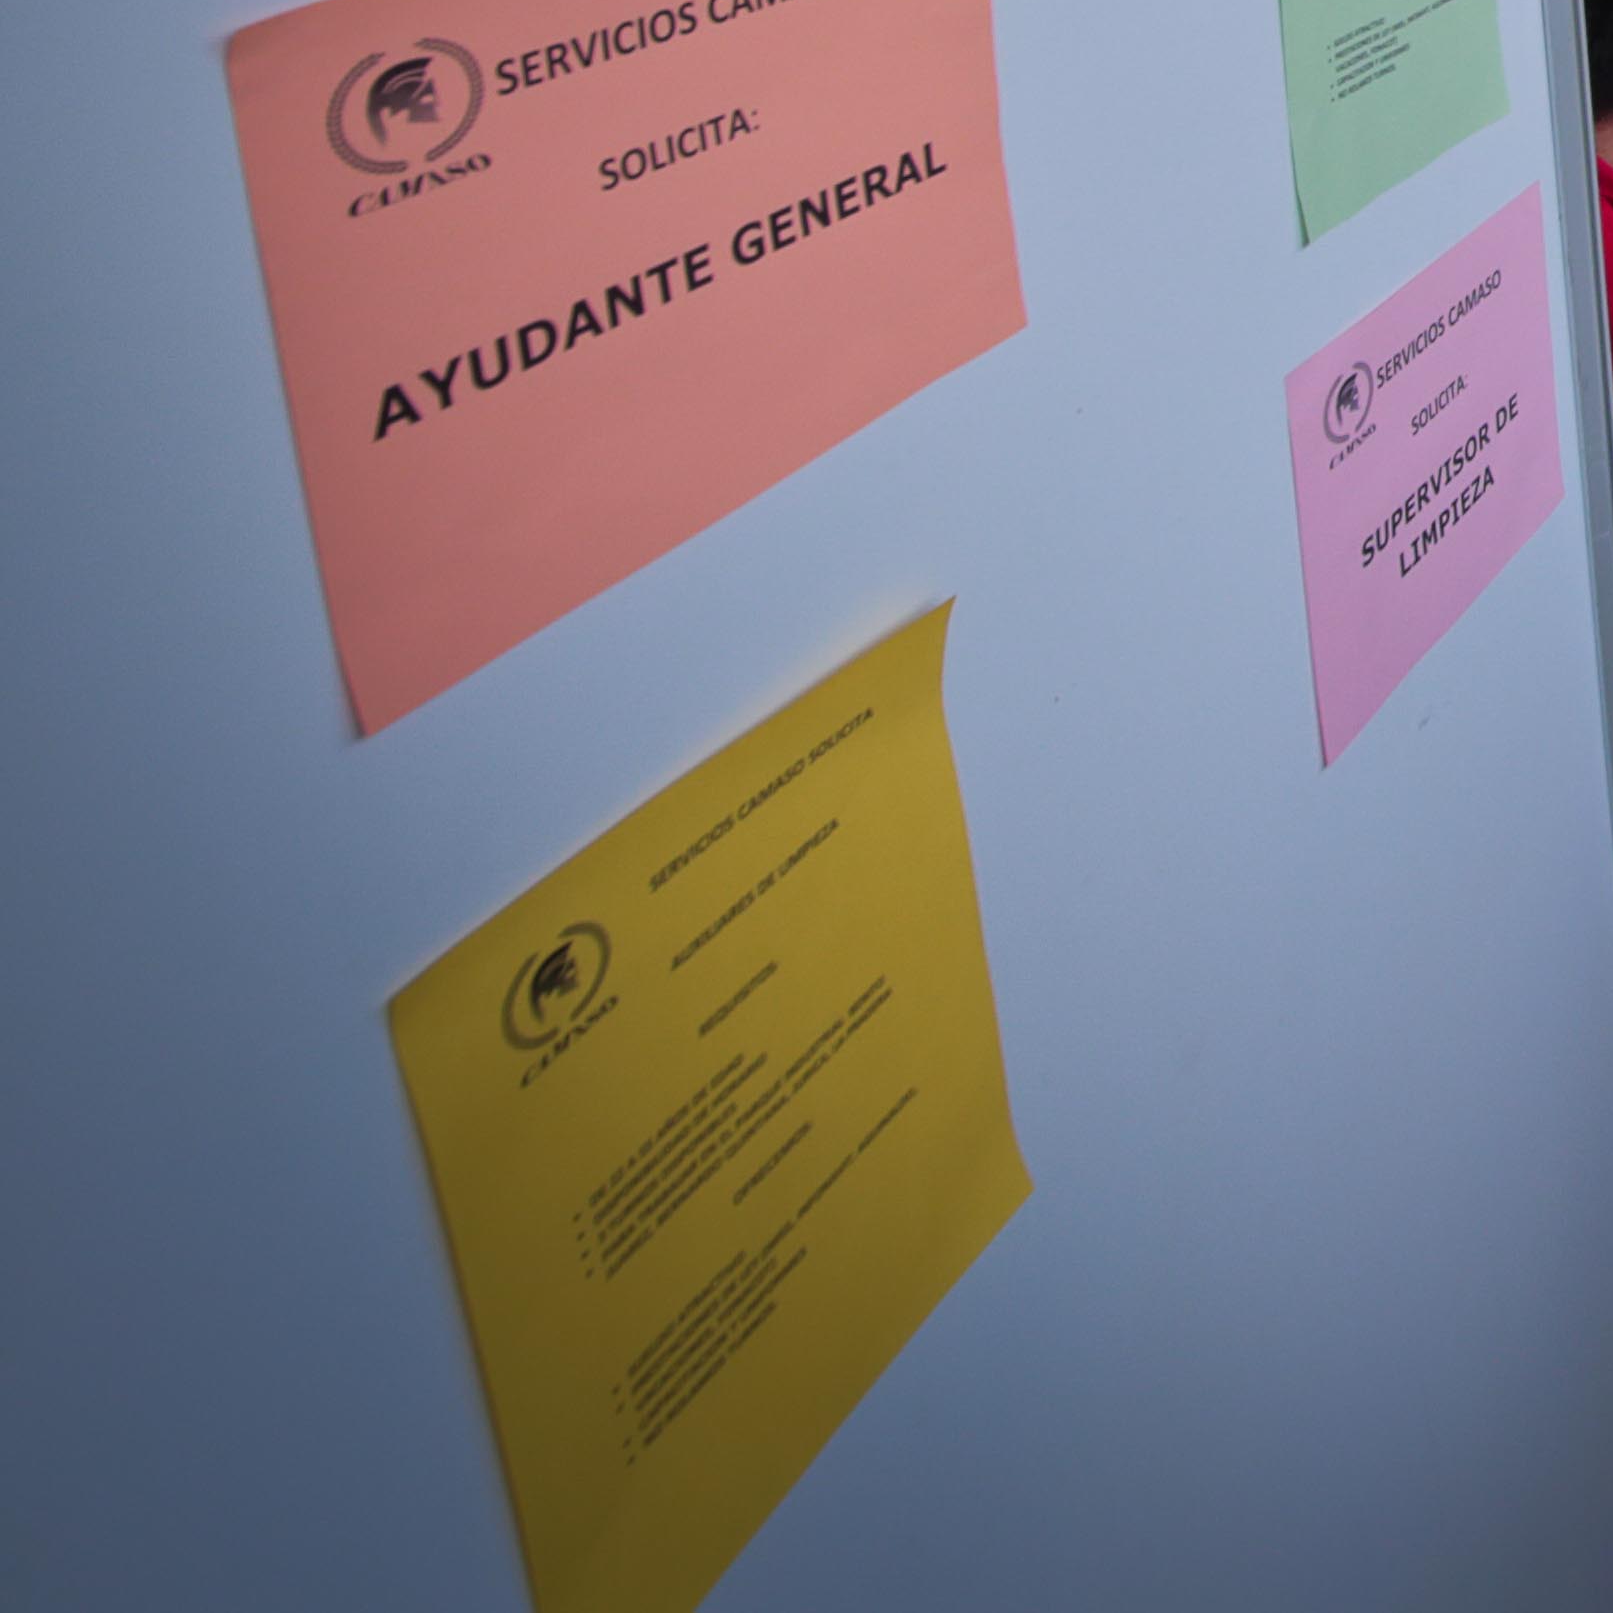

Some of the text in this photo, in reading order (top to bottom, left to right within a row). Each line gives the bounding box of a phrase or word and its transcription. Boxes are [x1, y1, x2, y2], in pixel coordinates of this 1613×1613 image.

[494, 0, 699, 97] SERVICIOS
[348, 150, 492, 220] CAMASO
[599, 106, 760, 192] SOLICITA:
[372, 139, 947, 443] AYUDANTE GENERAL
[1376, 269, 1501, 390] SERVICIOS CAMASO
[1329, 422, 1376, 470] CAMASO
[1411, 375, 1468, 437] SOLICITA:
[1361, 394, 1519, 568] SUPERVISOR DE
[1400, 465, 1495, 578] LIMPIEZA
[646, 703, 874, 895] SERVICIOS CAMASO SOLICITA
[755, 867, 777, 898] DE
